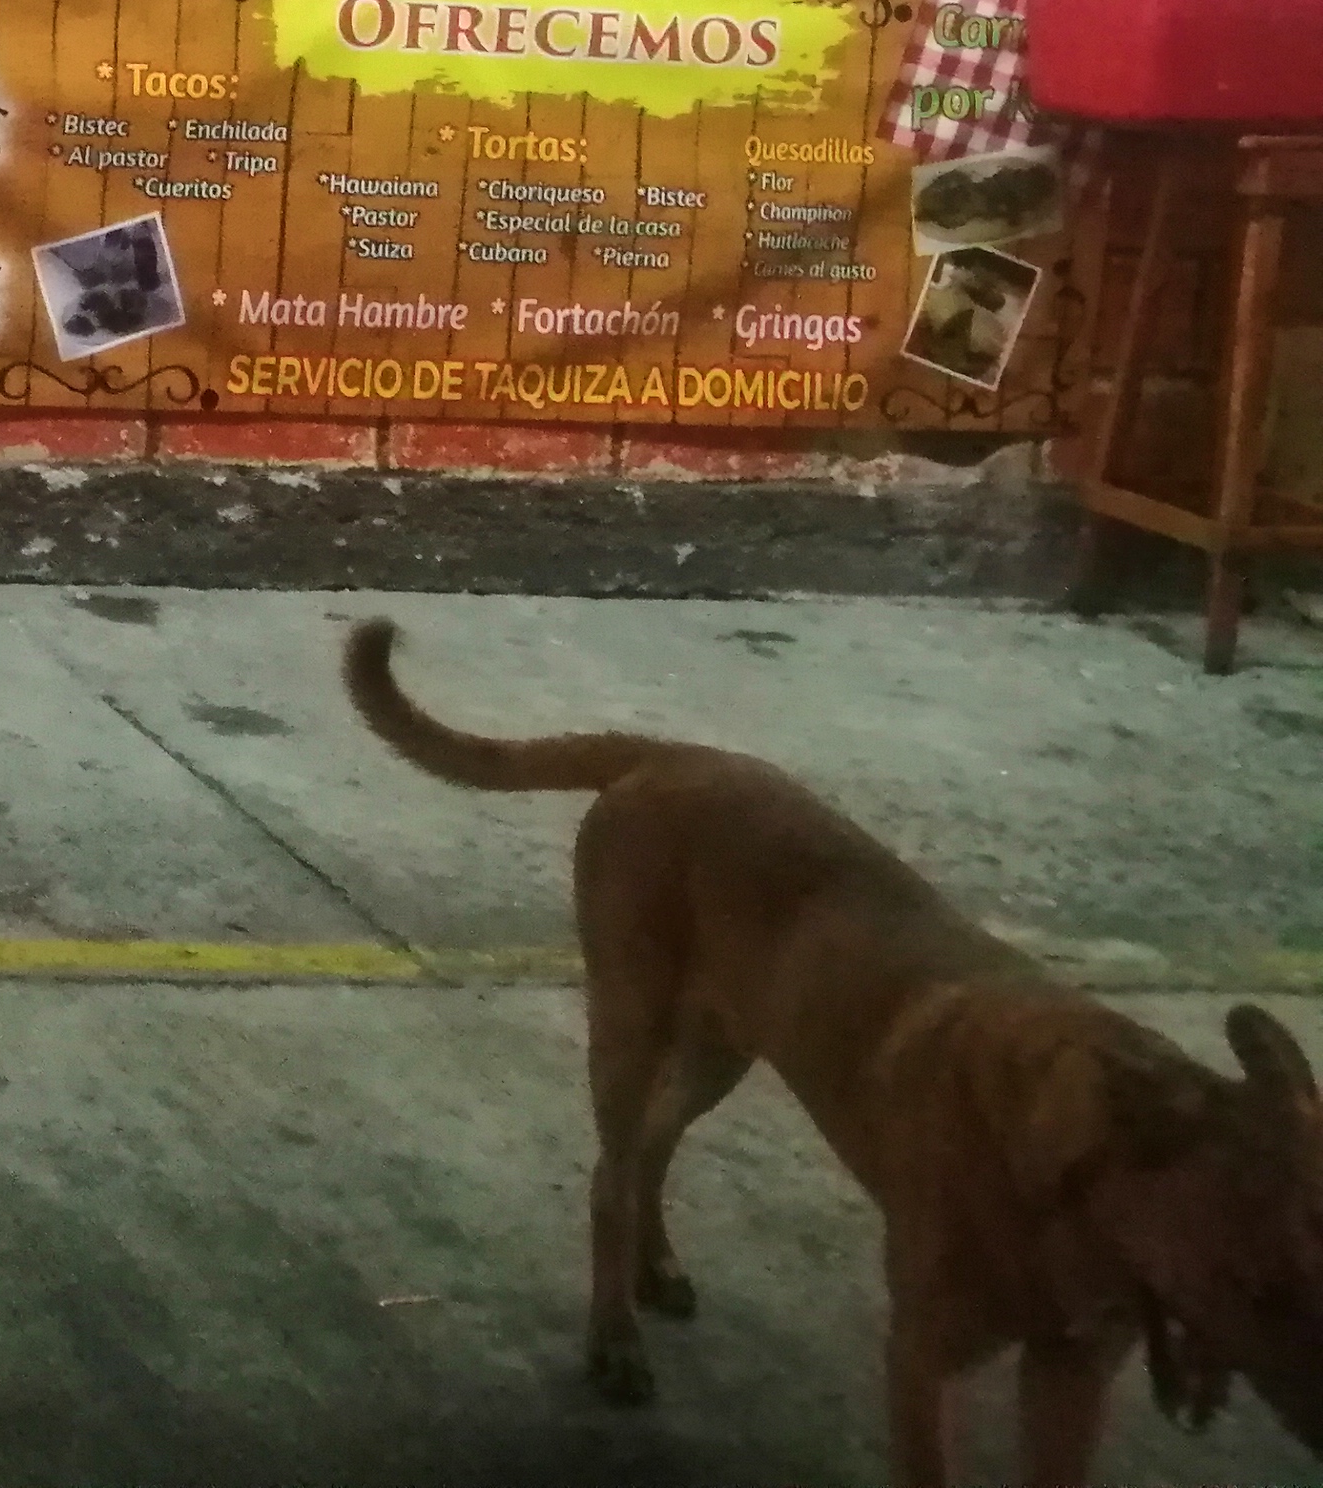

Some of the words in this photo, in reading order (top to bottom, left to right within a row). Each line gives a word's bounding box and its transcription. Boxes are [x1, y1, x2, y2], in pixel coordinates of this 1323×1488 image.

[126, 63, 239, 100] Tacos:
[912, 85, 995, 131] por
[63, 115, 130, 137] Bistec
[184, 119, 288, 141] Enchilada
[468, 126, 589, 163] Tortas:
[745, 136, 875, 166] Quesadillas
[67, 145, 94, 167] Al
[99, 146, 169, 171] pastor
[225, 152, 278, 175] Tripa
[143, 179, 233, 201] Cueritos
[329, 175, 439, 199] Hawaiana
[488, 181, 606, 206] Choriqueso
[646, 186, 707, 208] Bistec
[760, 172, 795, 192] Flor
[351, 207, 419, 229] Pastor
[486, 210, 571, 235] Especial
[577, 214, 604, 235] de
[608, 215, 630, 236] la
[635, 220, 682, 238] casa
[359, 239, 415, 260] Suiza
[469, 241, 548, 264] Cubana
[602, 246, 671, 269] Pierna
[808, 261, 825, 278] al
[829, 264, 877, 283] gusto
[238, 289, 326, 326] Mata
[338, 292, 469, 330] Hambre
[517, 298, 680, 337] Fortachón
[735, 305, 863, 351] Gringas
[226, 355, 403, 399] SERVICIO
[413, 360, 464, 400] DE
[475, 362, 633, 410] TAQUIZA
[641, 367, 668, 405] A
[677, 368, 869, 411] DOMICILIO
